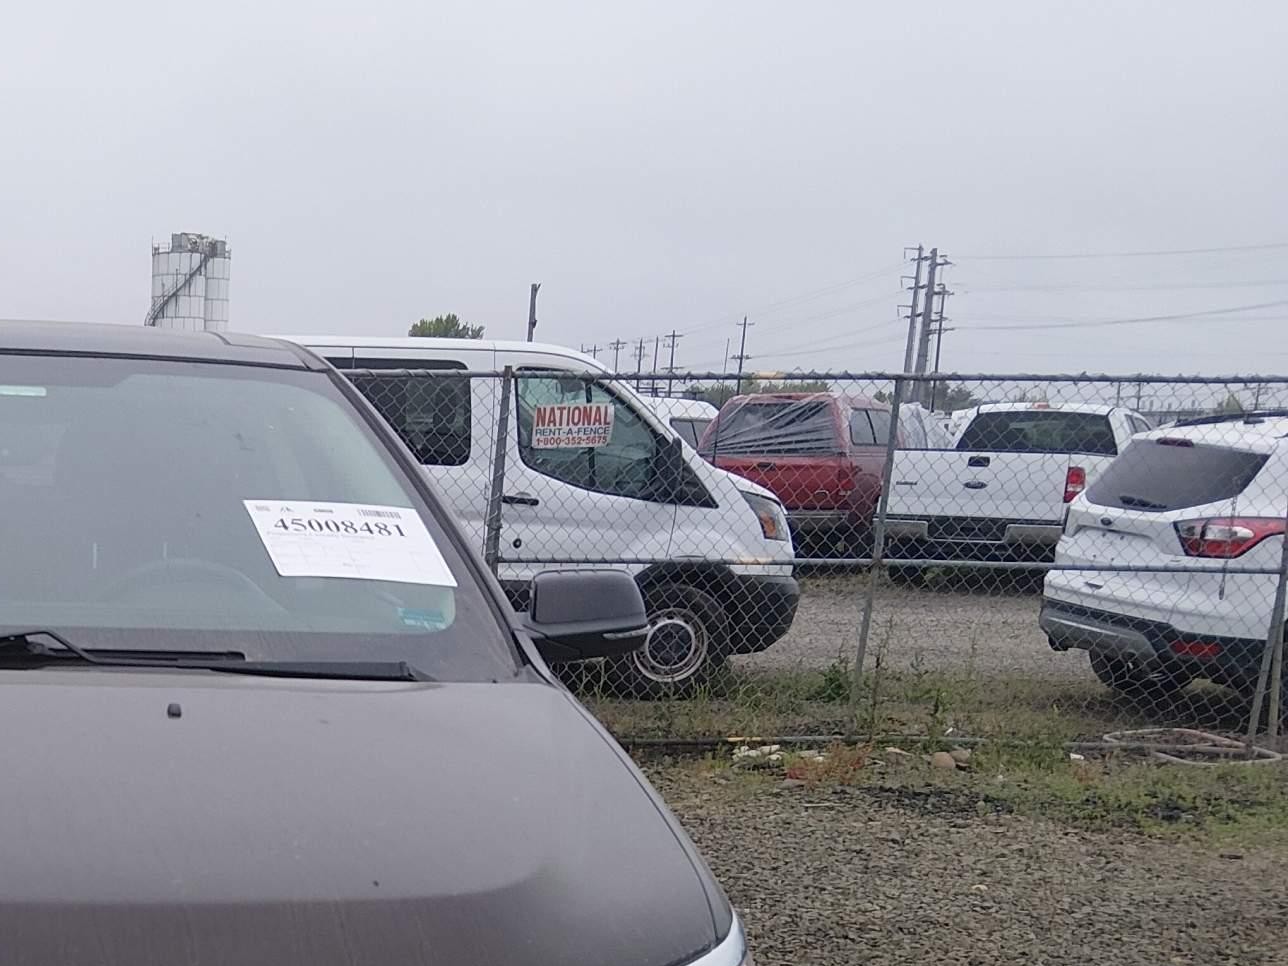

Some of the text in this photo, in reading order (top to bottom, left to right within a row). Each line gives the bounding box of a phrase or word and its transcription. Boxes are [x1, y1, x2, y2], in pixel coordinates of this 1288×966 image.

[536, 406, 610, 427] NATIONAL
[535, 427, 610, 436] RENT-A-FENCE
[273, 517, 408, 537] 45008481
